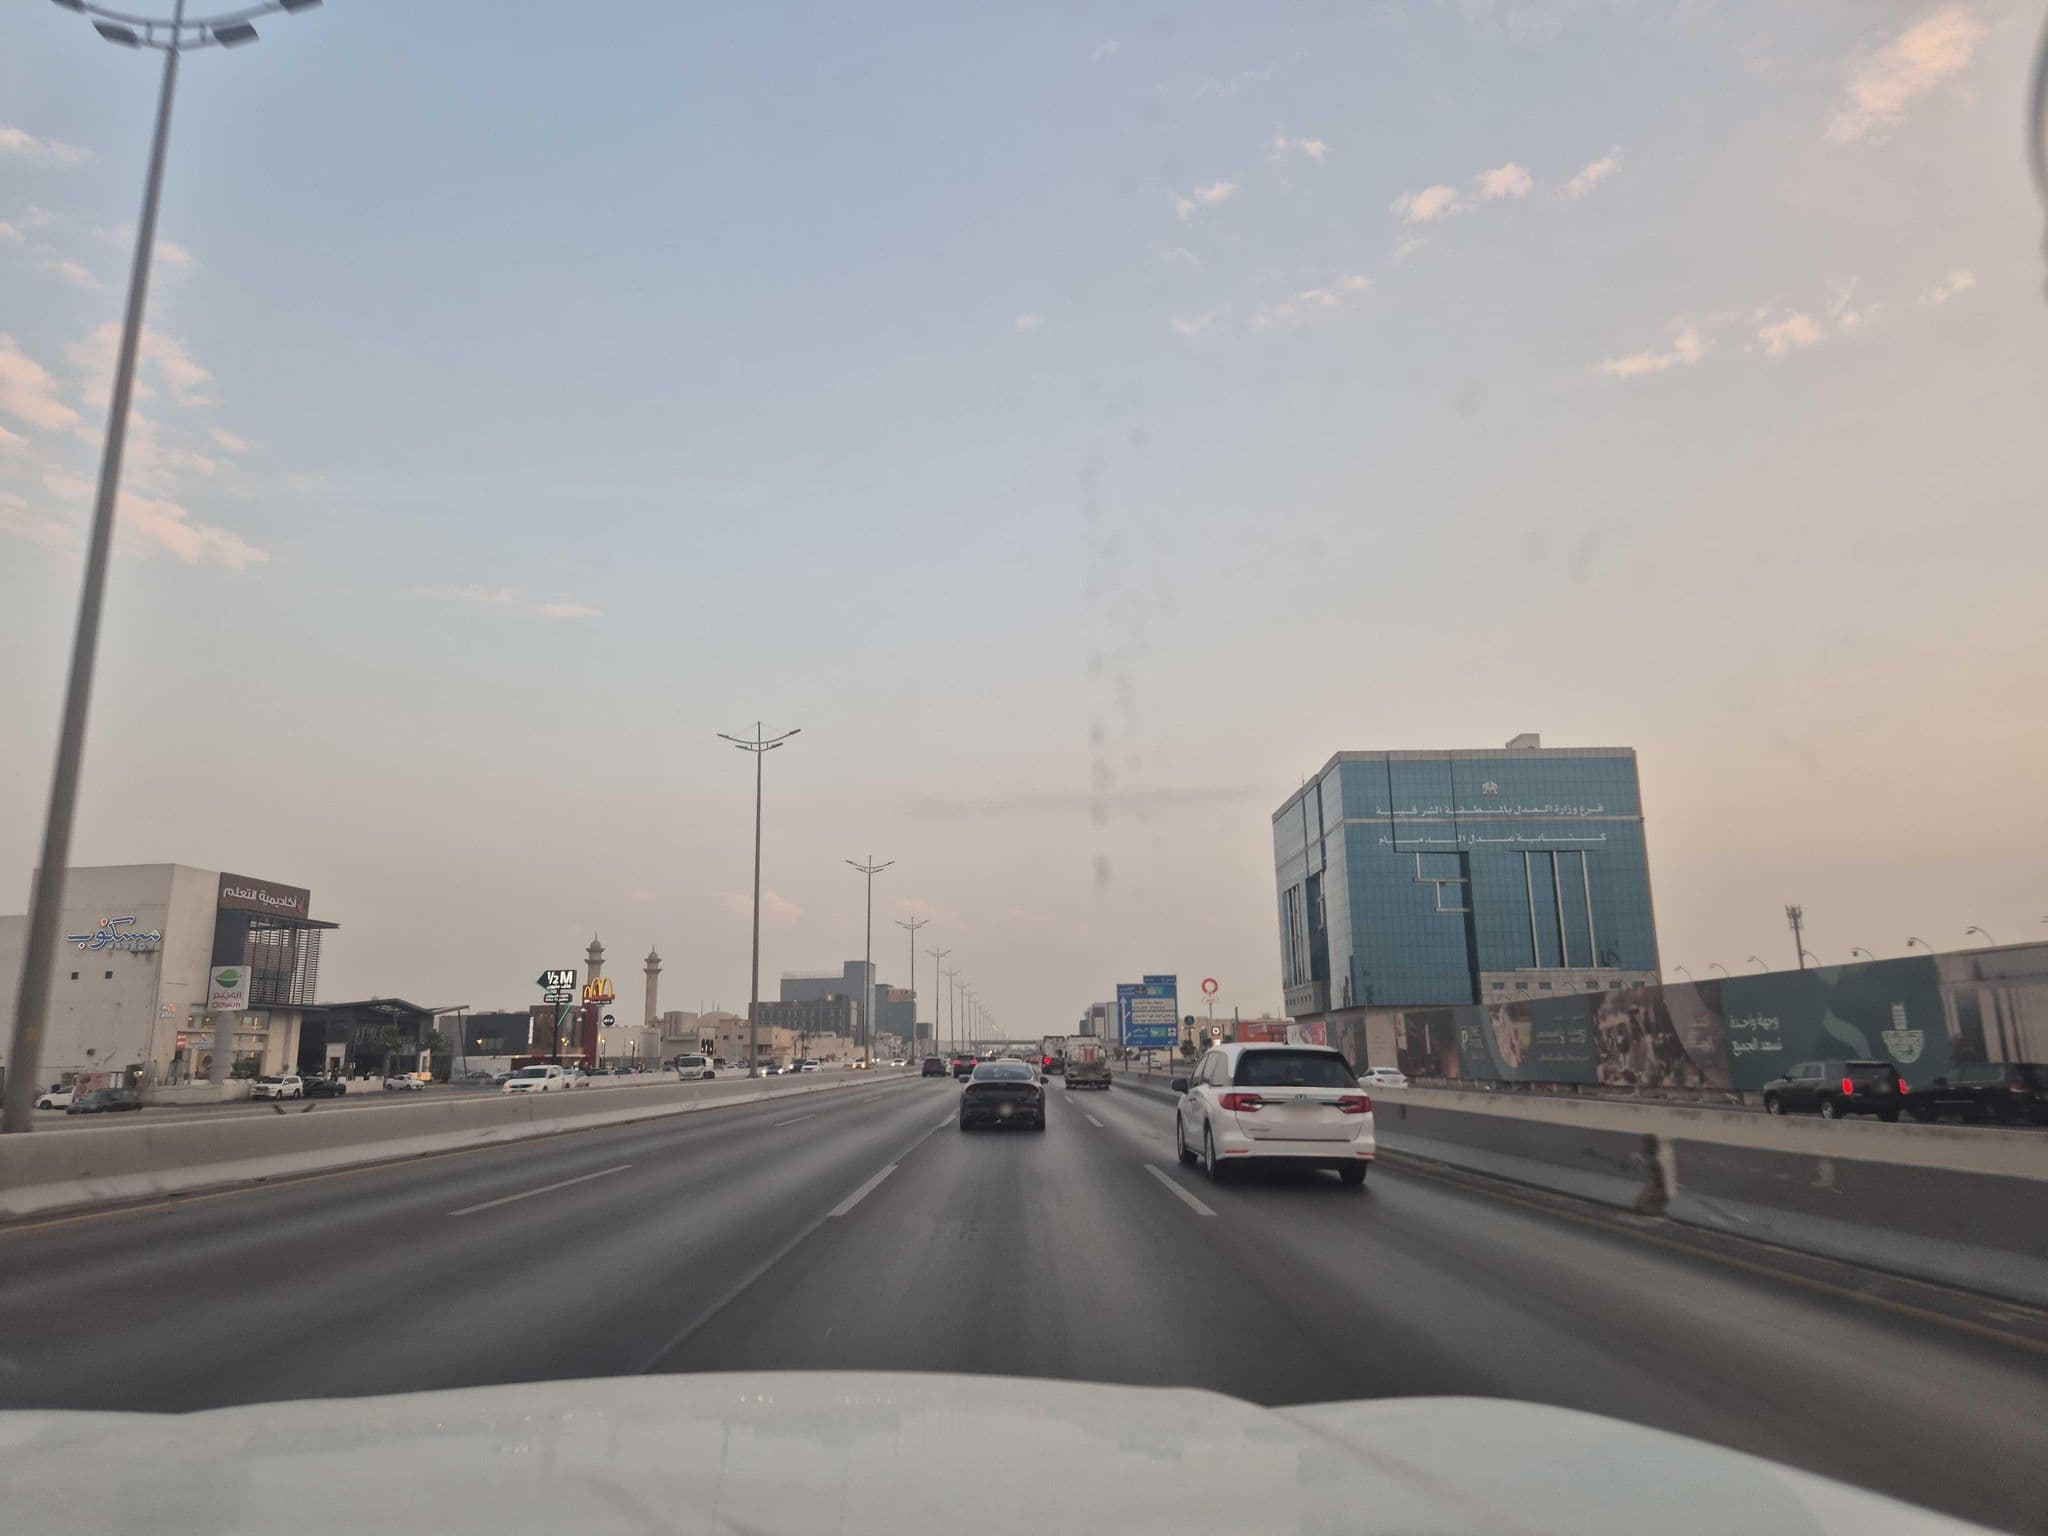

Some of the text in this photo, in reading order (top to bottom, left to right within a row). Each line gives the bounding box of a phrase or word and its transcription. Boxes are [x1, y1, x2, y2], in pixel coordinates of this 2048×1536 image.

[1375, 803, 1605, 817] فرع وزارة العدل بالمنطقة الشرقية
[1378, 832, 1607, 846] كتابة عدل الدمام
[223, 886, 257, 901] التعلم
